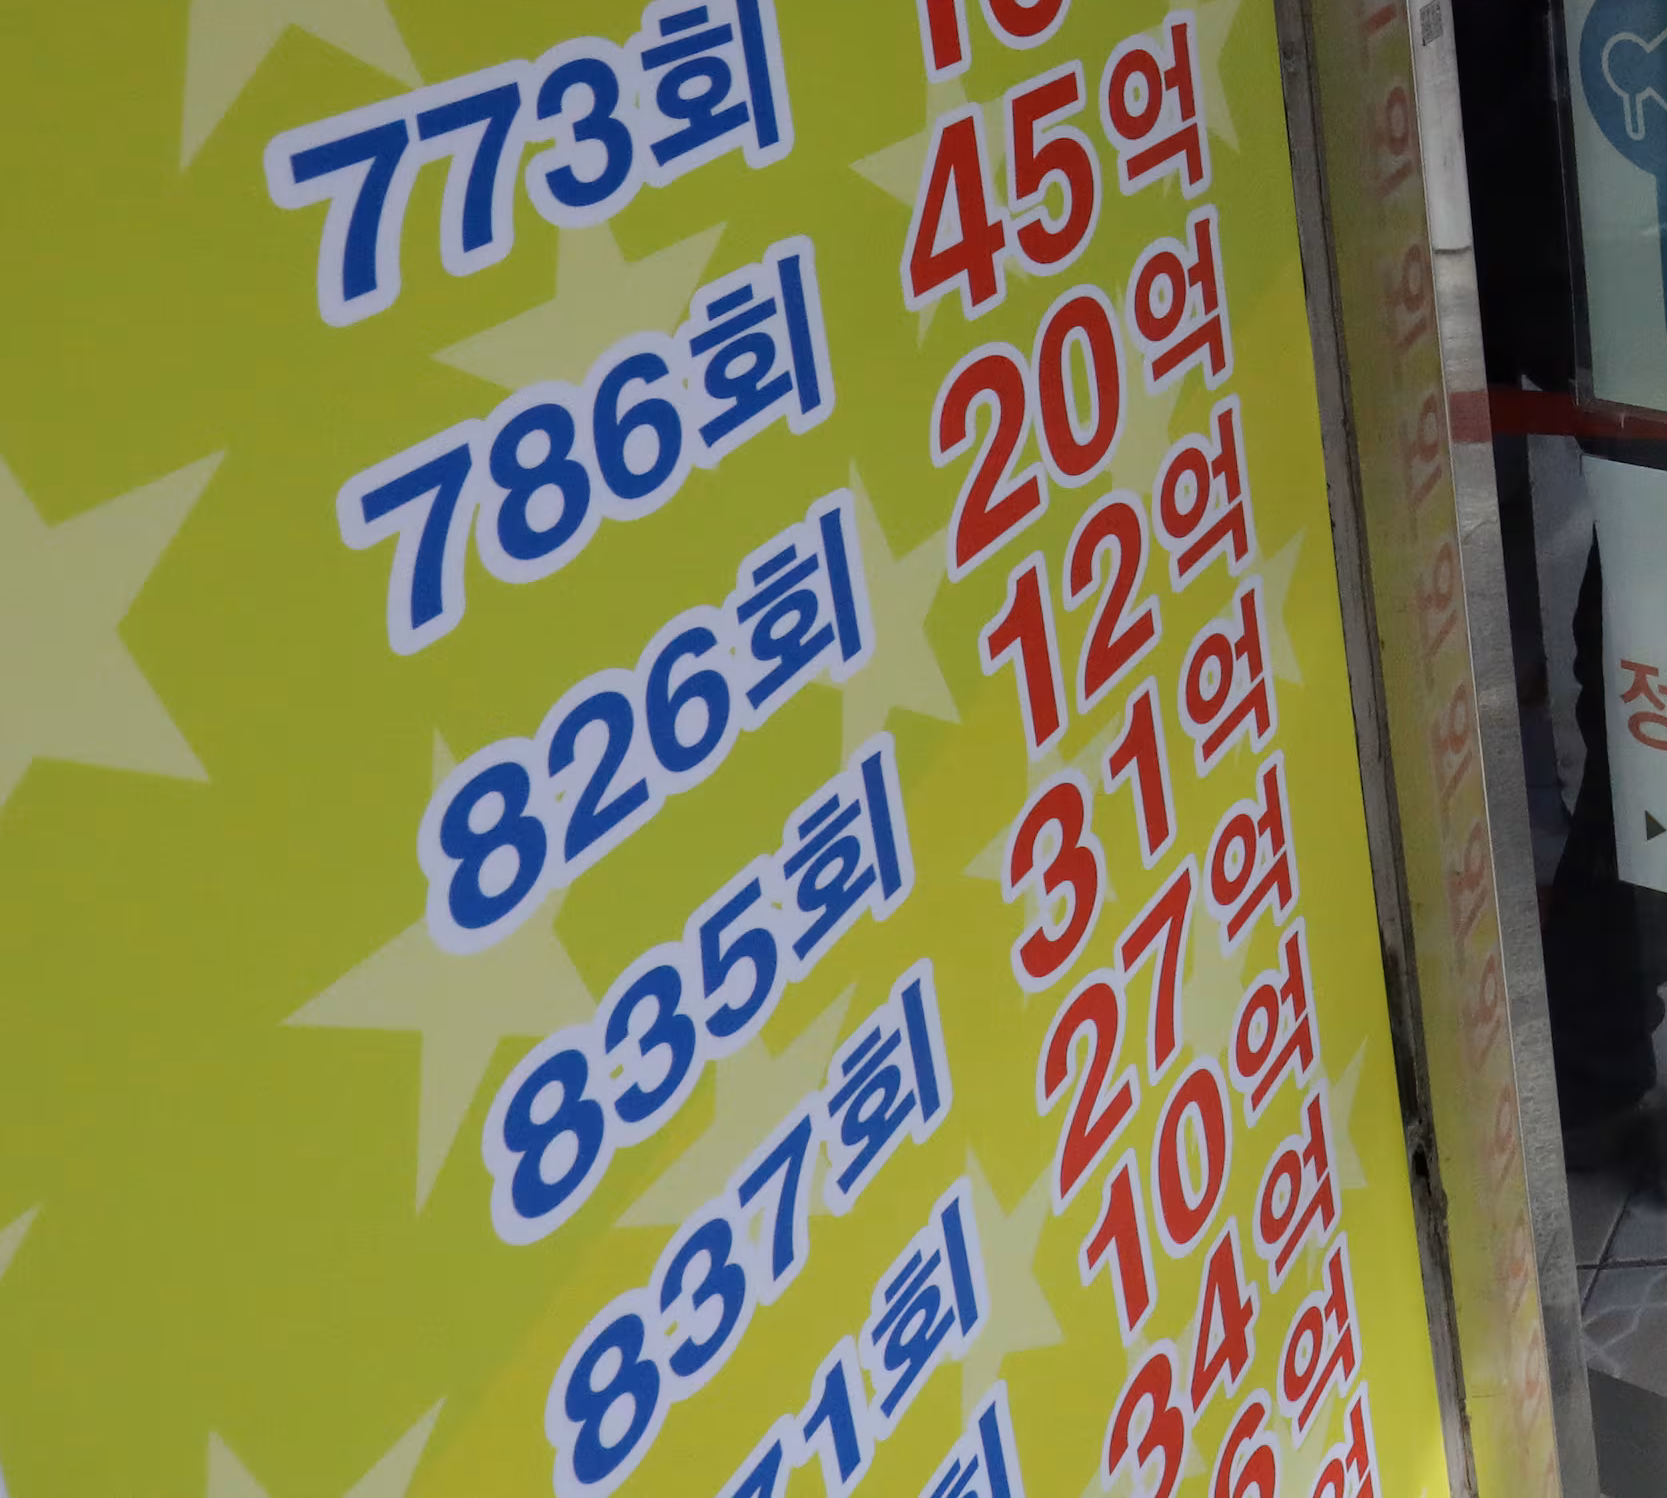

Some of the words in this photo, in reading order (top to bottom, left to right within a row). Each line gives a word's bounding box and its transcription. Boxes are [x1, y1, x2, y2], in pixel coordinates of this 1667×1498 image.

[910, 22, 1204, 308] 45억
[352, 252, 823, 629] 786회
[937, 217, 1229, 568] 20억
[986, 407, 1249, 749] 12억
[438, 506, 863, 929] 826회
[1008, 590, 1272, 980] 31억
[502, 751, 909, 1221] 835회
[1044, 766, 1294, 1200] 27억
[1085, 931, 1314, 1333] 10억
[562, 980, 939, 1486] 837회
[1109, 1094, 1337, 1498] 34억
